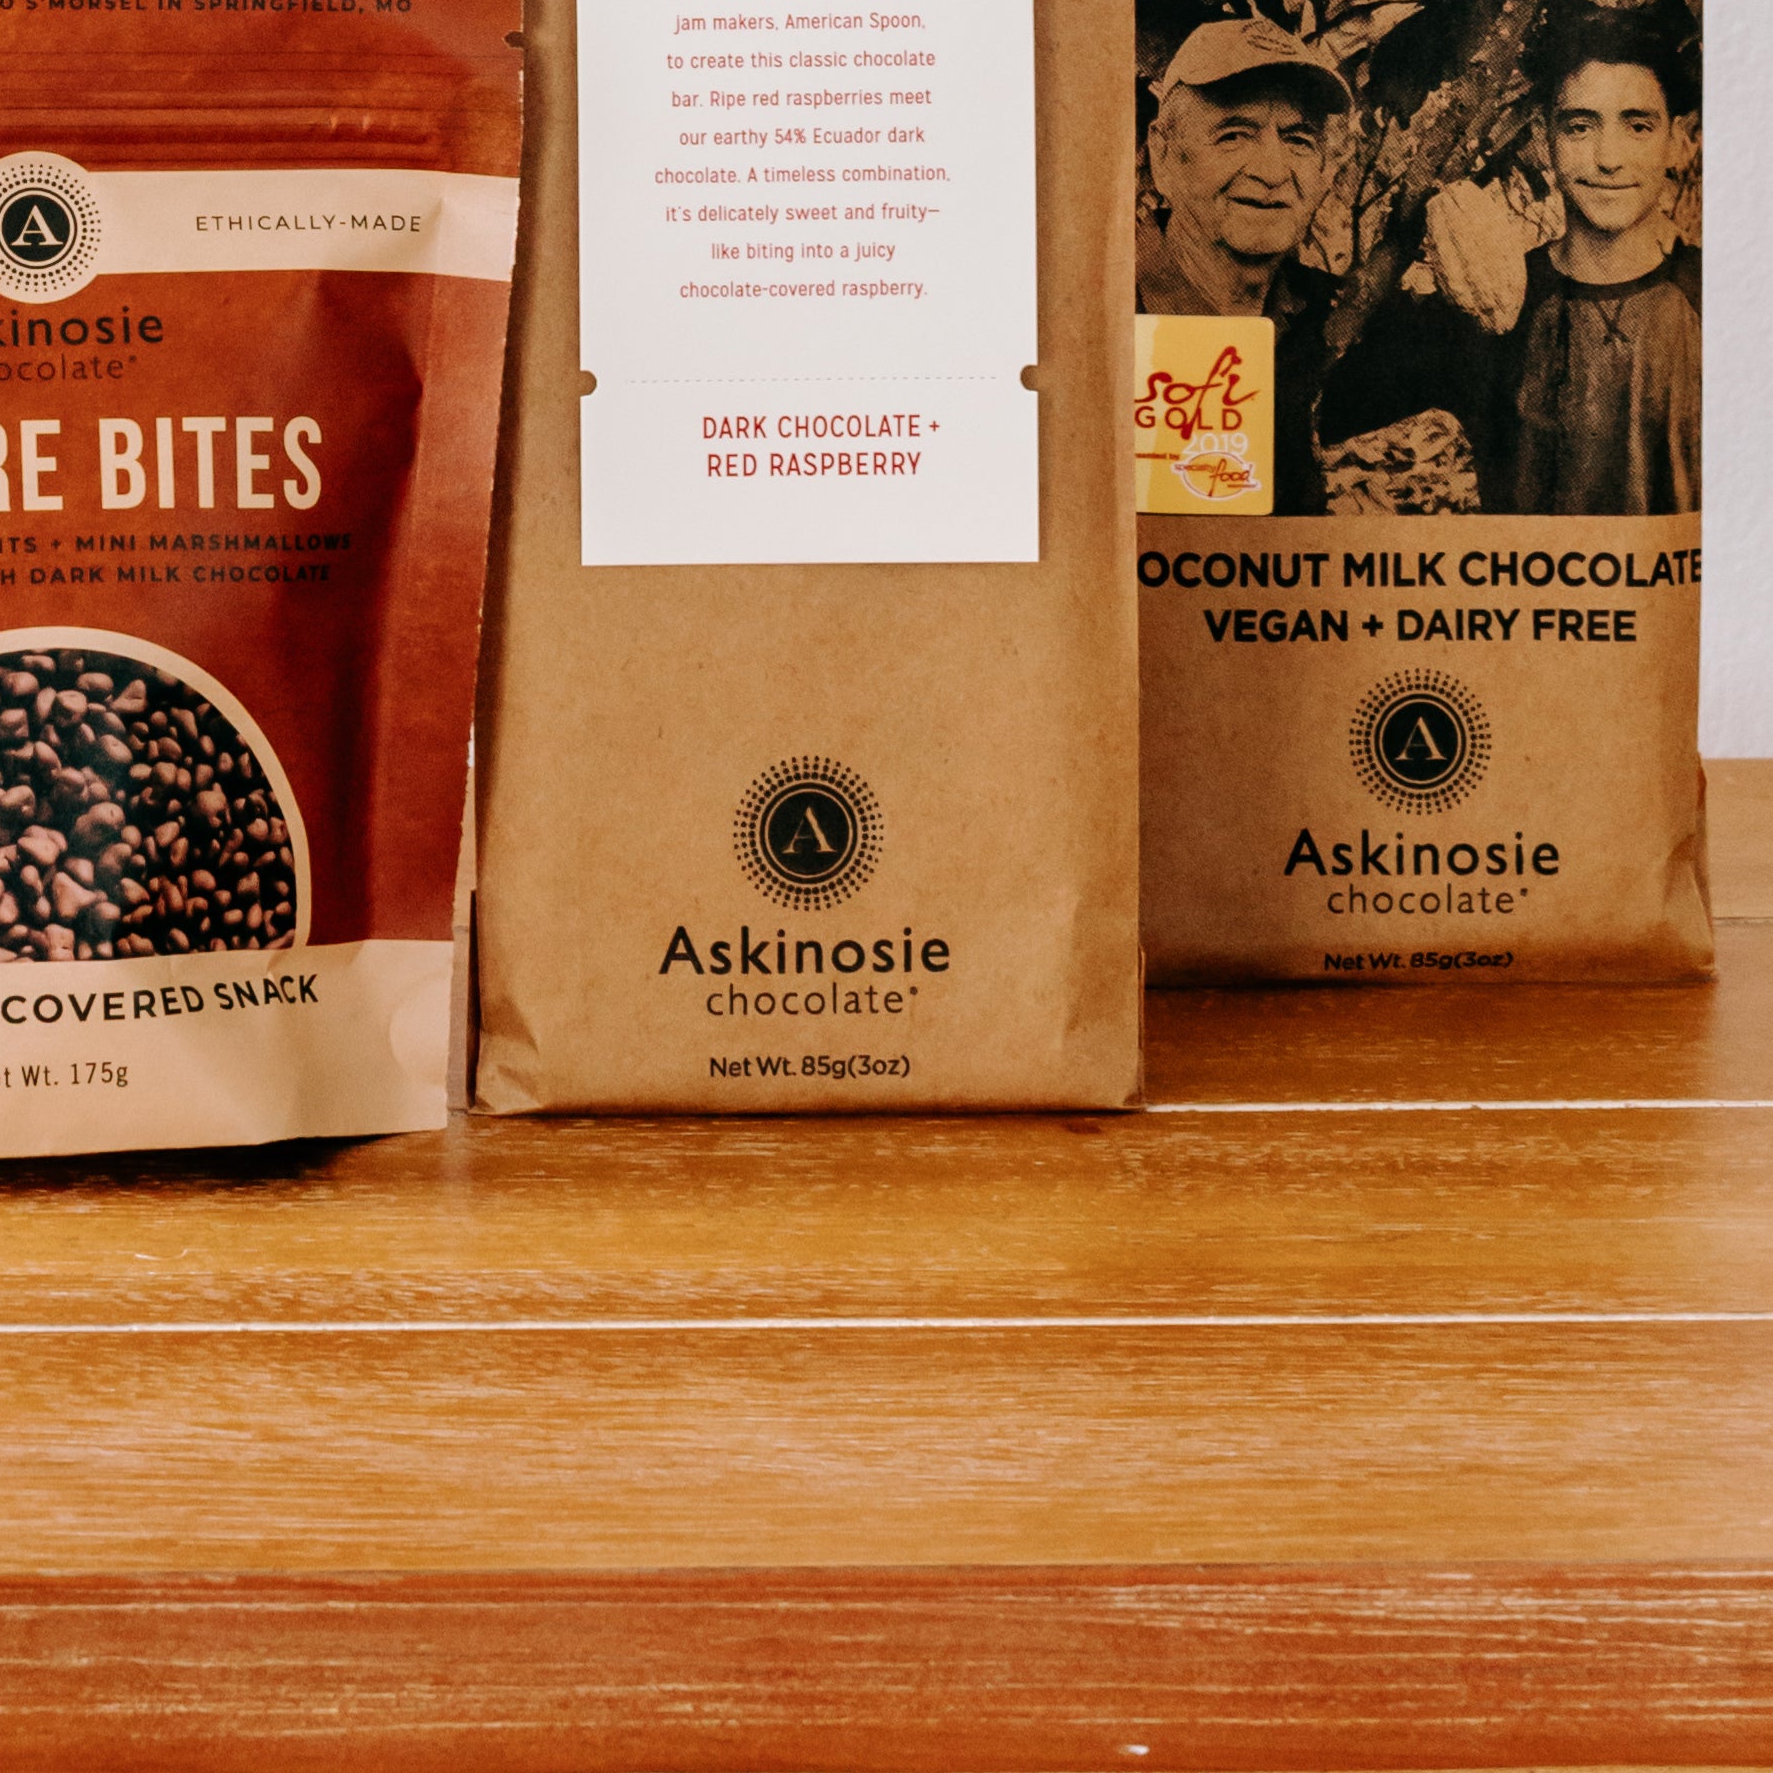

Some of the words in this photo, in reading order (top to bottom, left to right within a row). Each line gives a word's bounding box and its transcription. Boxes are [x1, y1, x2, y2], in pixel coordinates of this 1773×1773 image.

[673, 14, 706, 35] jam
[713, 13, 779, 31] makers,
[785, 13, 863, 30] American
[869, 12, 926, 32] Spoon,
[667, 53, 684, 69] to
[690, 53, 745, 69] create
[751, 52, 783, 68] this
[789, 51, 847, 68] classic
[853, 50, 936, 67] chocolate
[672, 91, 703, 108] bar.
[709, 90, 746, 110] Ripe
[753, 90, 779, 106] red
[786, 89, 883, 109] raspberries
[890, 89, 932, 105] meet
[679, 132, 706, 147] our
[713, 129, 768, 149] earthy
[774, 127, 806, 145] 54%
[813, 127, 881, 144] Ecuador
[887, 126, 925, 143] dark
[655, 167, 741, 184] chocolate.
[747, 167, 758, 183] A
[763, 166, 835, 183] timeless
[842, 165, 951, 182] combination,
[11, 204, 64, 246] A
[196, 215, 421, 233] ETHICALLY-MADE
[665, 206, 692, 222] it's
[698, 205, 779, 225] delicately
[785, 206, 837, 222] sweet
[844, 204, 875, 221] and
[711, 243, 740, 260] like
[746, 243, 794, 263] biting
[801, 242, 833, 259] into
[839, 246, 850, 259] a
[854, 242, 896, 262] juicy
[679, 280, 836, 299] chocolate-covered
[842, 281, 927, 300] raspberry.
[702, 416, 768, 440] DARK
[778, 414, 922, 439] CHOCOLATE
[928, 419, 941, 433] +
[1134, 406, 1242, 430] GOLD
[1182, 432, 1249, 455] 2019
[98, 416, 323, 511] BITES
[707, 453, 757, 477] RED
[769, 451, 922, 477] RASPBERRY
[51, 539, 62, 550] +
[76, 534, 136, 552] MINI
[150, 532, 352, 551] MARSHMALLOWS
[30, 566, 104, 585] DARK
[117, 566, 182, 584] MILK
[192, 564, 331, 582] CHOCOLATE
[1344, 551, 1446, 588] MILK
[1459, 547, 1702, 588] CHOCOLATE
[1204, 609, 1349, 643] VEGAN
[1362, 615, 1384, 638] +
[1397, 608, 1521, 642] DAIRY
[1532, 609, 1637, 642] FREE
[1395, 716, 1447, 761] A
[782, 807, 836, 854] A
[1284, 828, 1560, 877] Askinosie
[659, 925, 950, 975] Askinosie
[1324, 952, 1364, 971] Net
[1368, 952, 1406, 970] Wt.
[1410, 951, 1514, 970] 85g(3oz)
[1, 985, 205, 1025] COVERED
[214, 973, 320, 1012] SNACK
[21, 1065, 59, 1088] Wt.
[70, 1062, 129, 1089] 175g
[710, 1057, 751, 1077] Net
[756, 1056, 796, 1076] Wt.
[801, 1055, 911, 1079] 85g(3oz)
